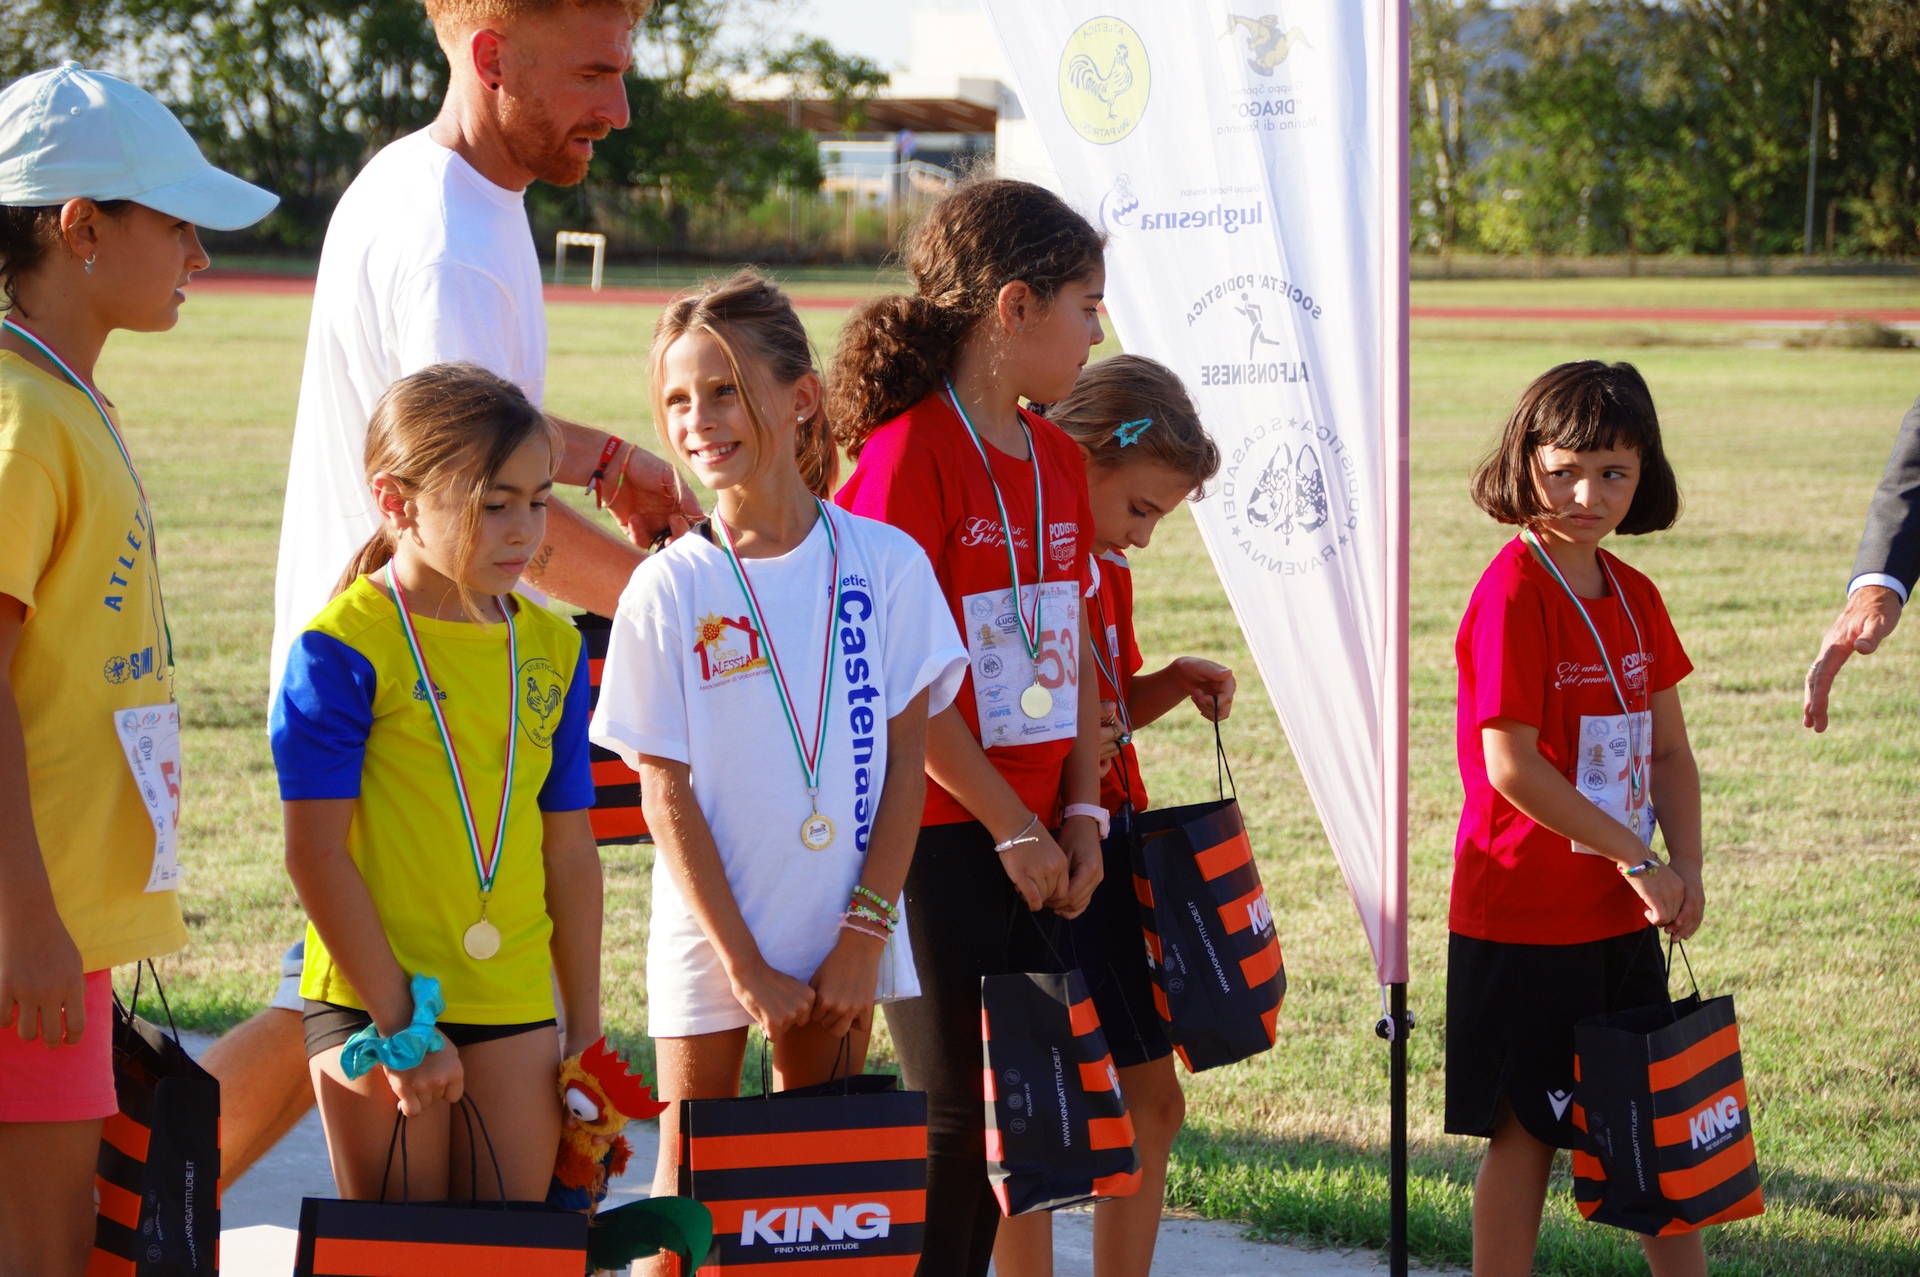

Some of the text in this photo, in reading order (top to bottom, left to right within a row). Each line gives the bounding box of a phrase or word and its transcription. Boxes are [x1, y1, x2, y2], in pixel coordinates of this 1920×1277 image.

[712, 654, 754, 677] ALESSIA
[713, 648, 739, 661] Casa
[1033, 628, 1078, 690] 53
[412, 689, 447, 701] adias
[699, 679, 731, 692] Associazione
[837, 590, 881, 853] Castenaso
[1689, 1096, 1741, 1150] KING
[740, 1203, 891, 1246] KING
[774, 1242, 859, 1254] FIND YOUR ATTITUDE
